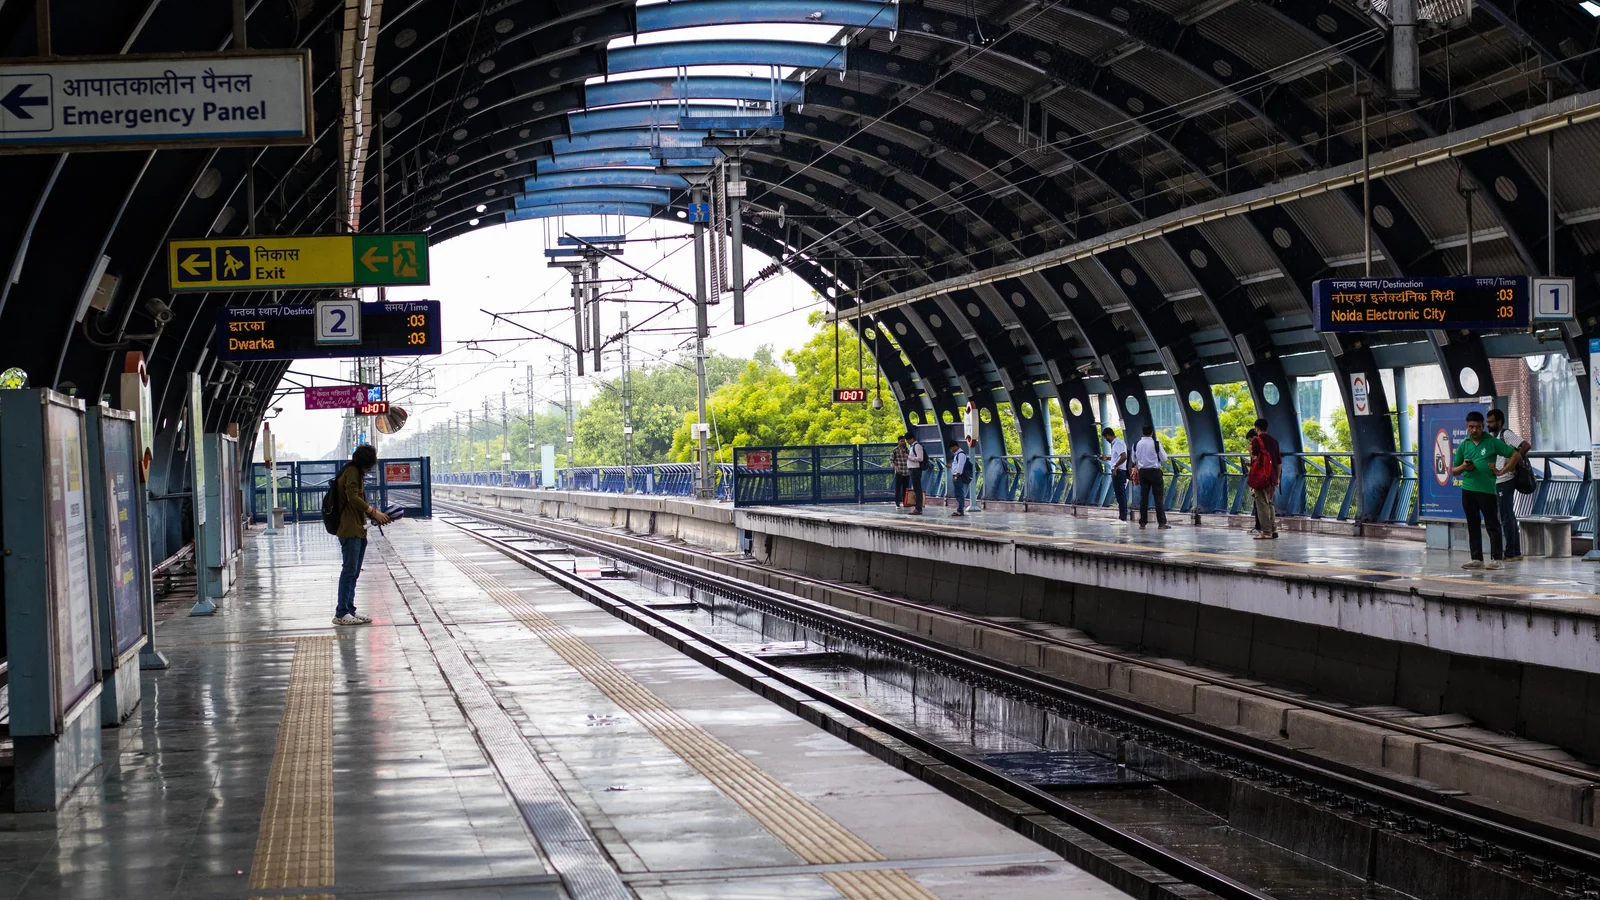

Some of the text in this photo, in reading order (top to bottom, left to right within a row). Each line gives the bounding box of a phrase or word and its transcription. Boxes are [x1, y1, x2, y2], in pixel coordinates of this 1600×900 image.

[62, 67, 253, 98] आपातकालीन पैनल
[63, 101, 266, 129] Emergency Panel
[696, 203, 702, 213] 5
[254, 245, 300, 262] निकास
[256, 266, 285, 279] Exit
[1475, 277, 1517, 287] समय/Time
[1331, 292, 1367, 306] नोएडा
[1430, 289, 1455, 302] सिटी
[1549, 288, 1561, 310] 1
[384, 303, 428, 312] समय/Time
[330, 309, 347, 333] 2
[1331, 307, 1446, 322] Noida Electronic City
[228, 320, 266, 332] द्वारका
[228, 337, 275, 351] Dwarka
[338, 397, 352, 406] Only
[840, 390, 864, 401] 10:07
[361, 403, 386, 414] 10:07
